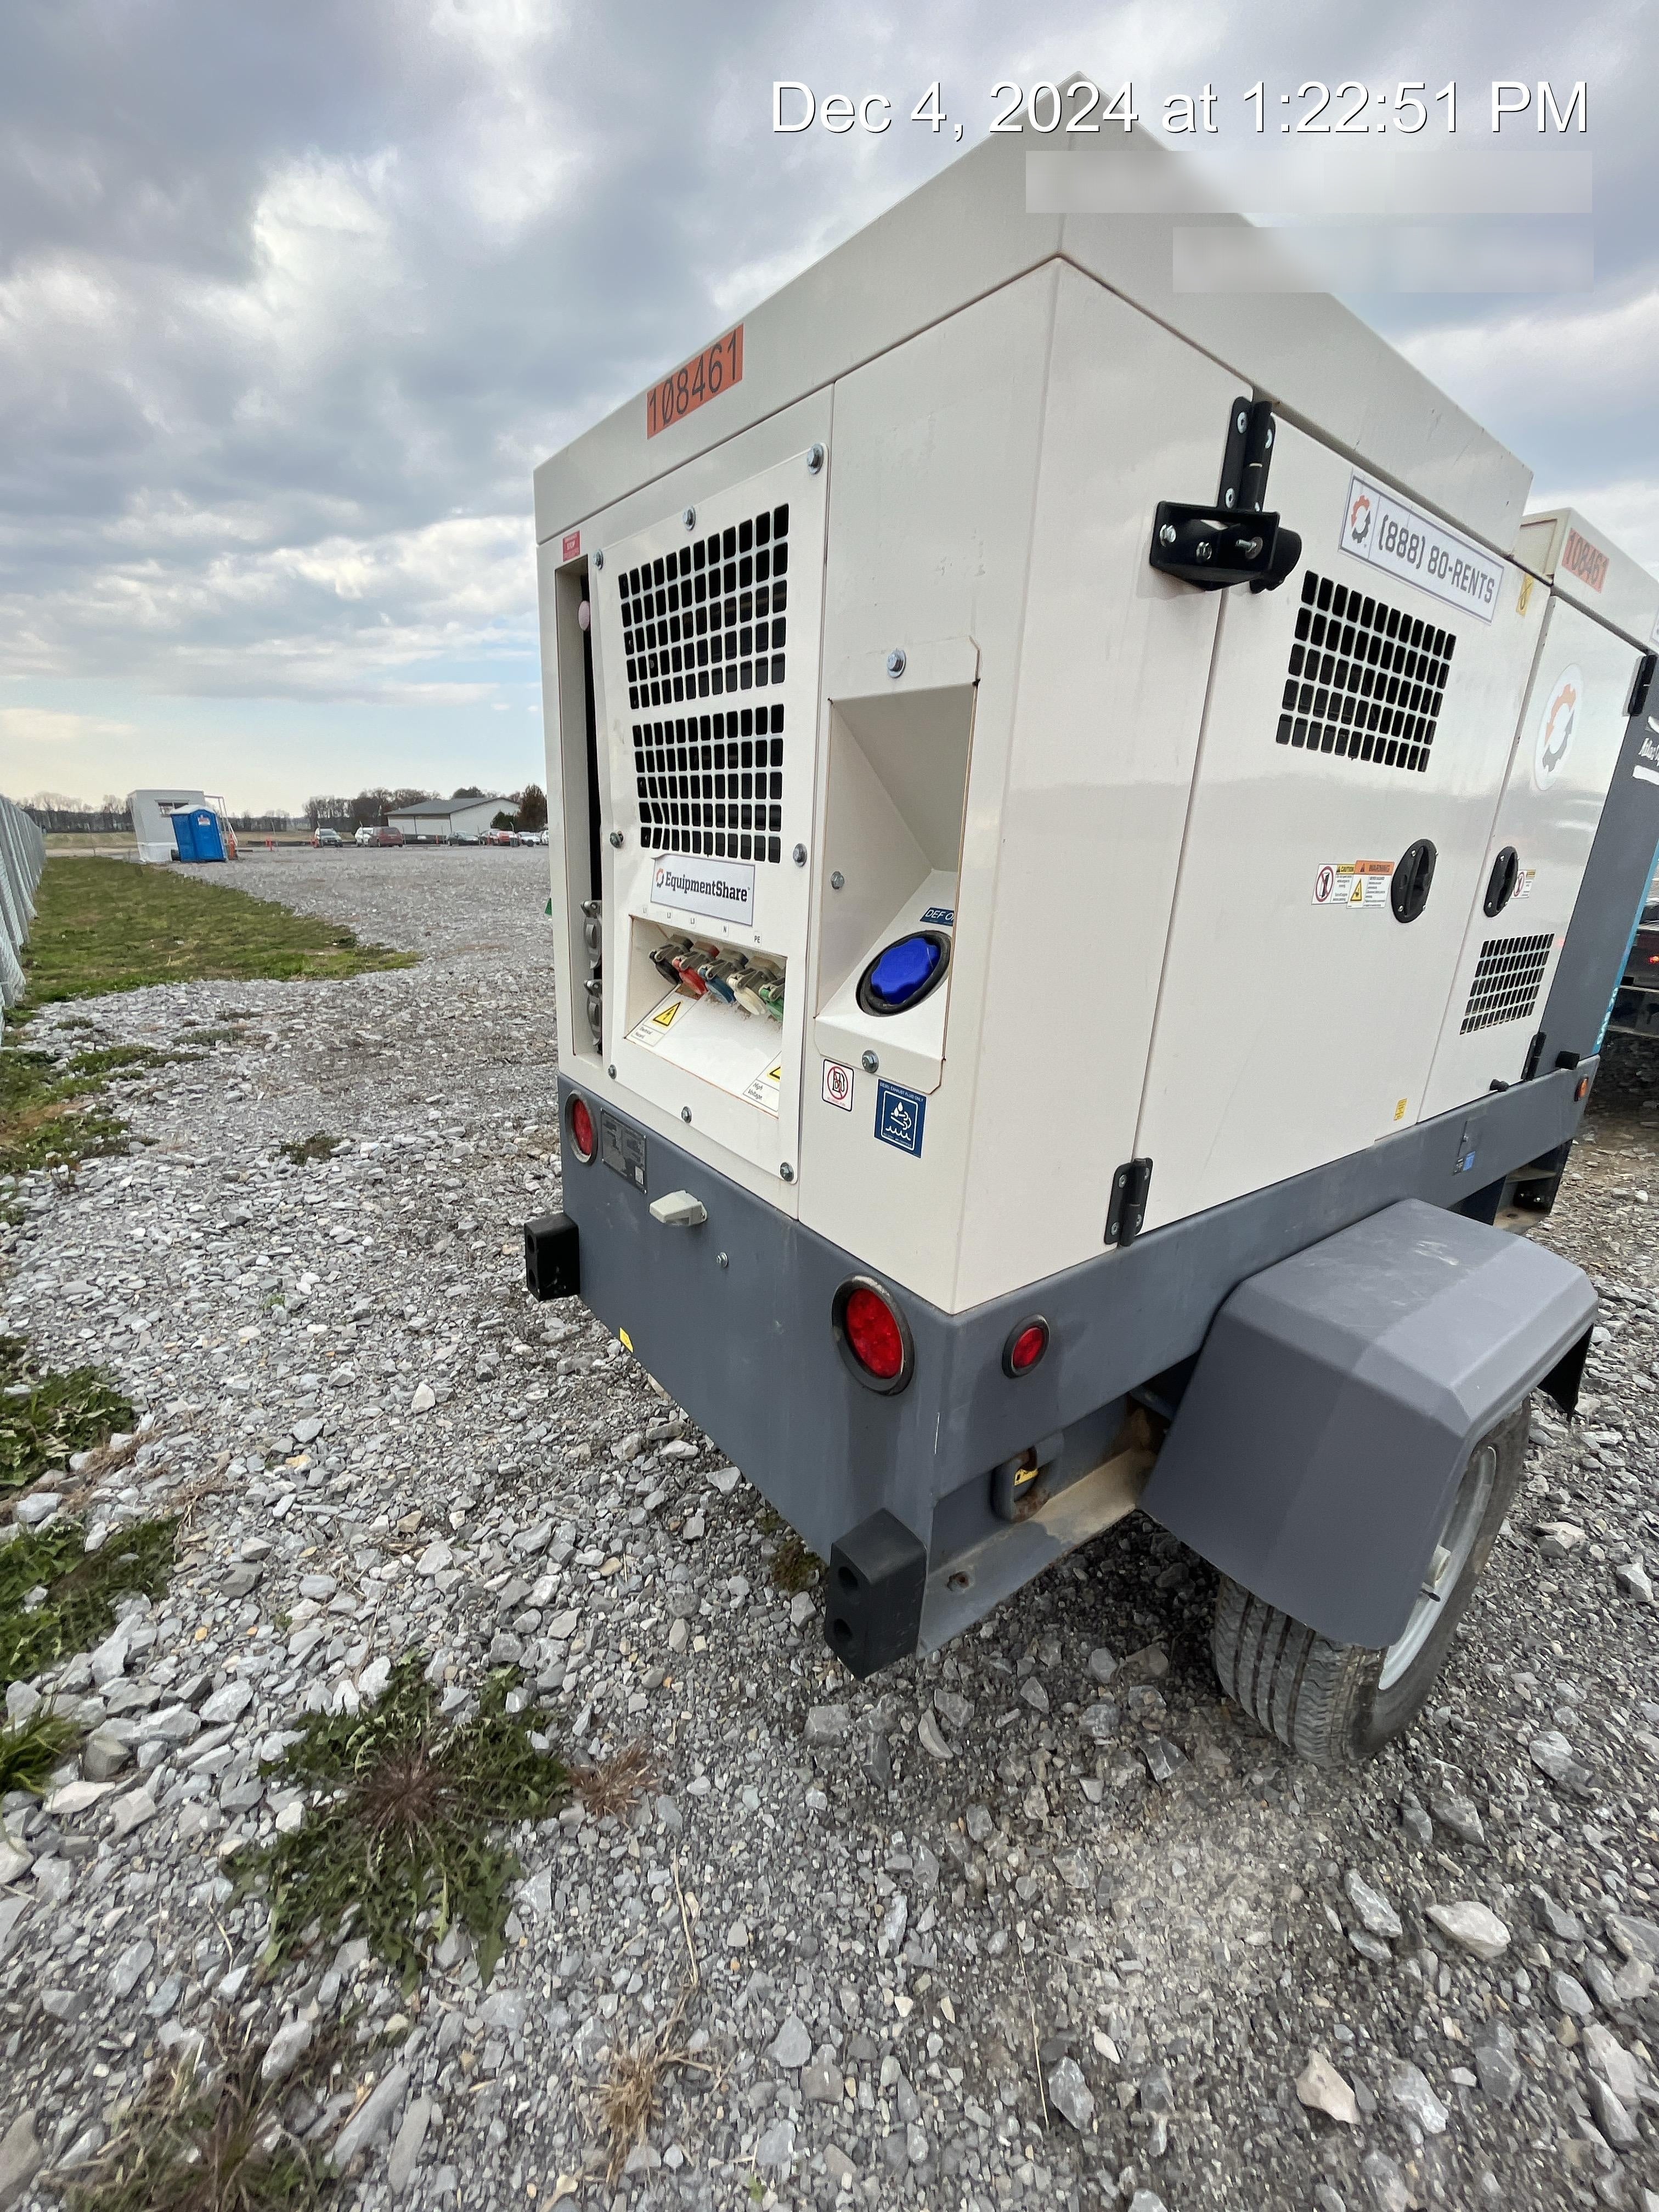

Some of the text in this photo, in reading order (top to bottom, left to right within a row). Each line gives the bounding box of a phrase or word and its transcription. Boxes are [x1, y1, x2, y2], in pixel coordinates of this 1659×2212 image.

[649, 329, 737, 432] 108461
[1379, 514, 1495, 603] (888) 80-RENTS
[665, 871, 748, 902] EquipmentShare
[925, 910, 946, 919] DEF
[754, 935, 760, 944] PE
